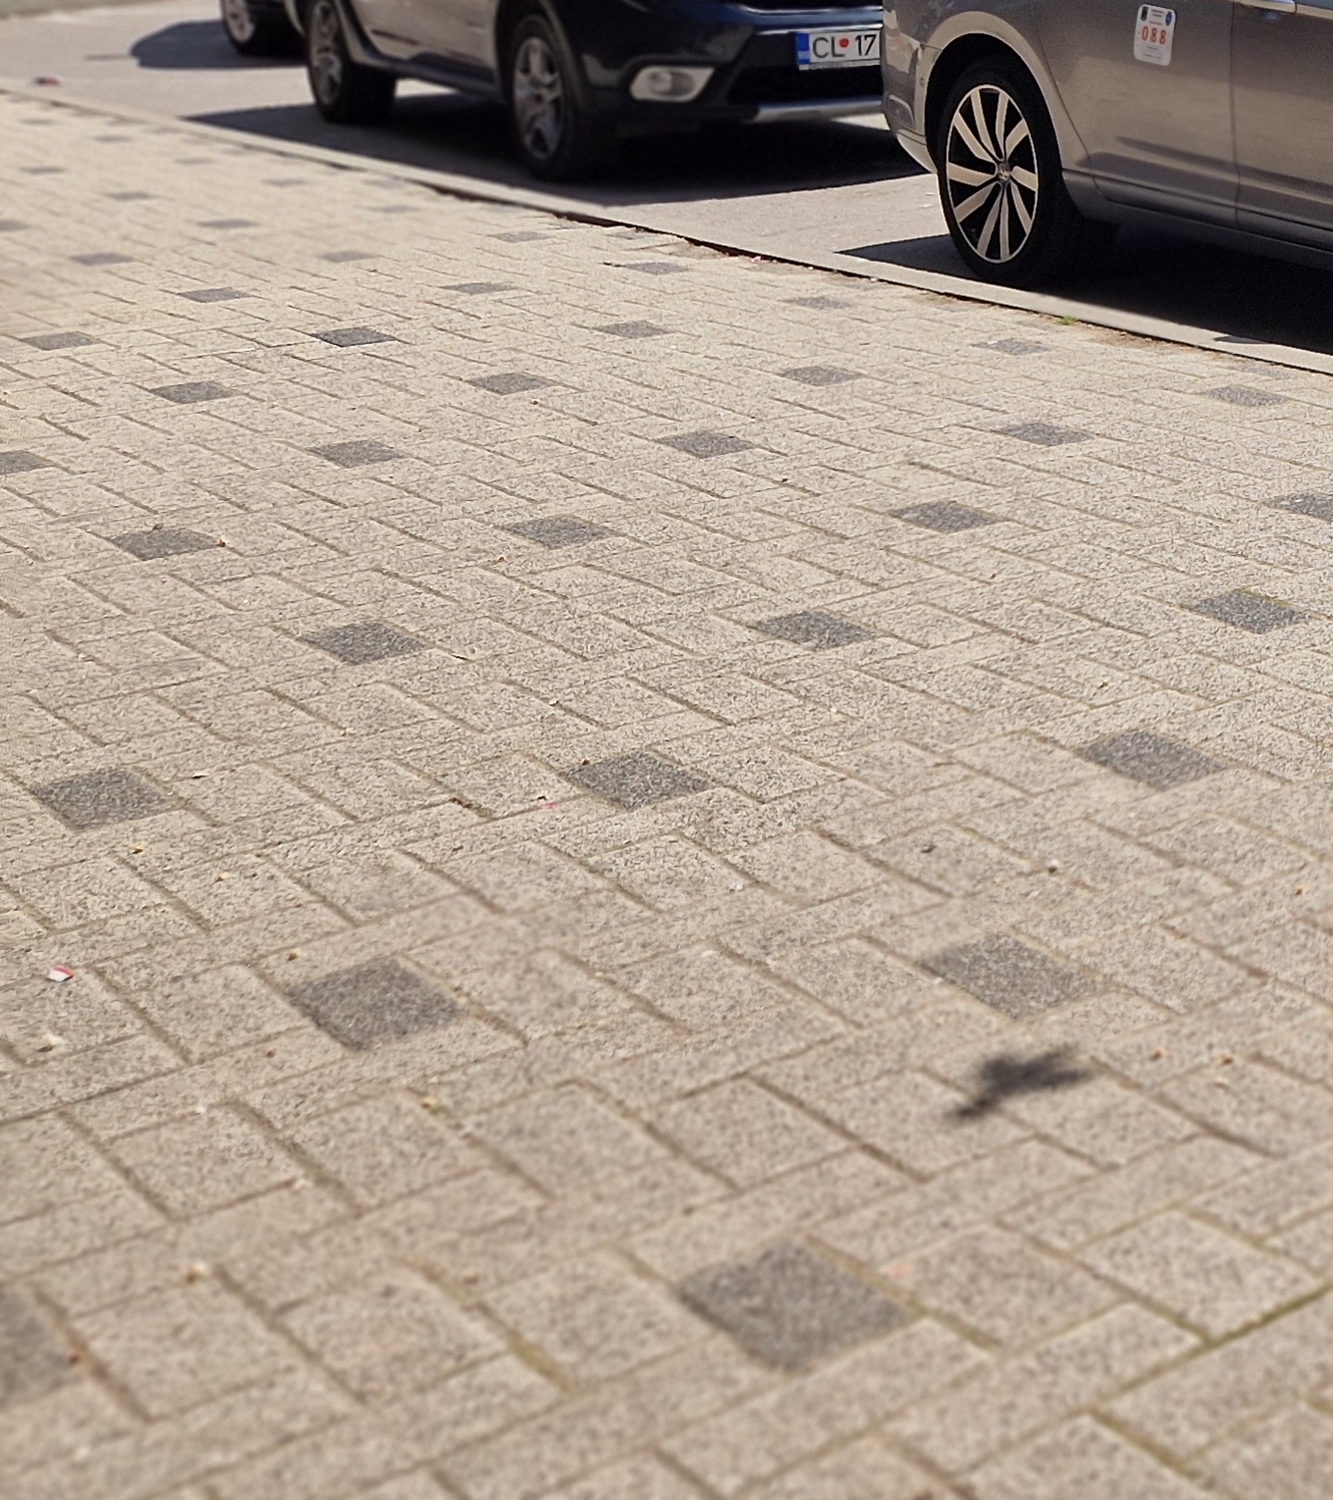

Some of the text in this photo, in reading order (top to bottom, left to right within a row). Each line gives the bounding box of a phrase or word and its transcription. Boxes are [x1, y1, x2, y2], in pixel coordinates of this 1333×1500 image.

[1142, 25, 1166, 44] 088
[812, 33, 877, 59] CL 17
